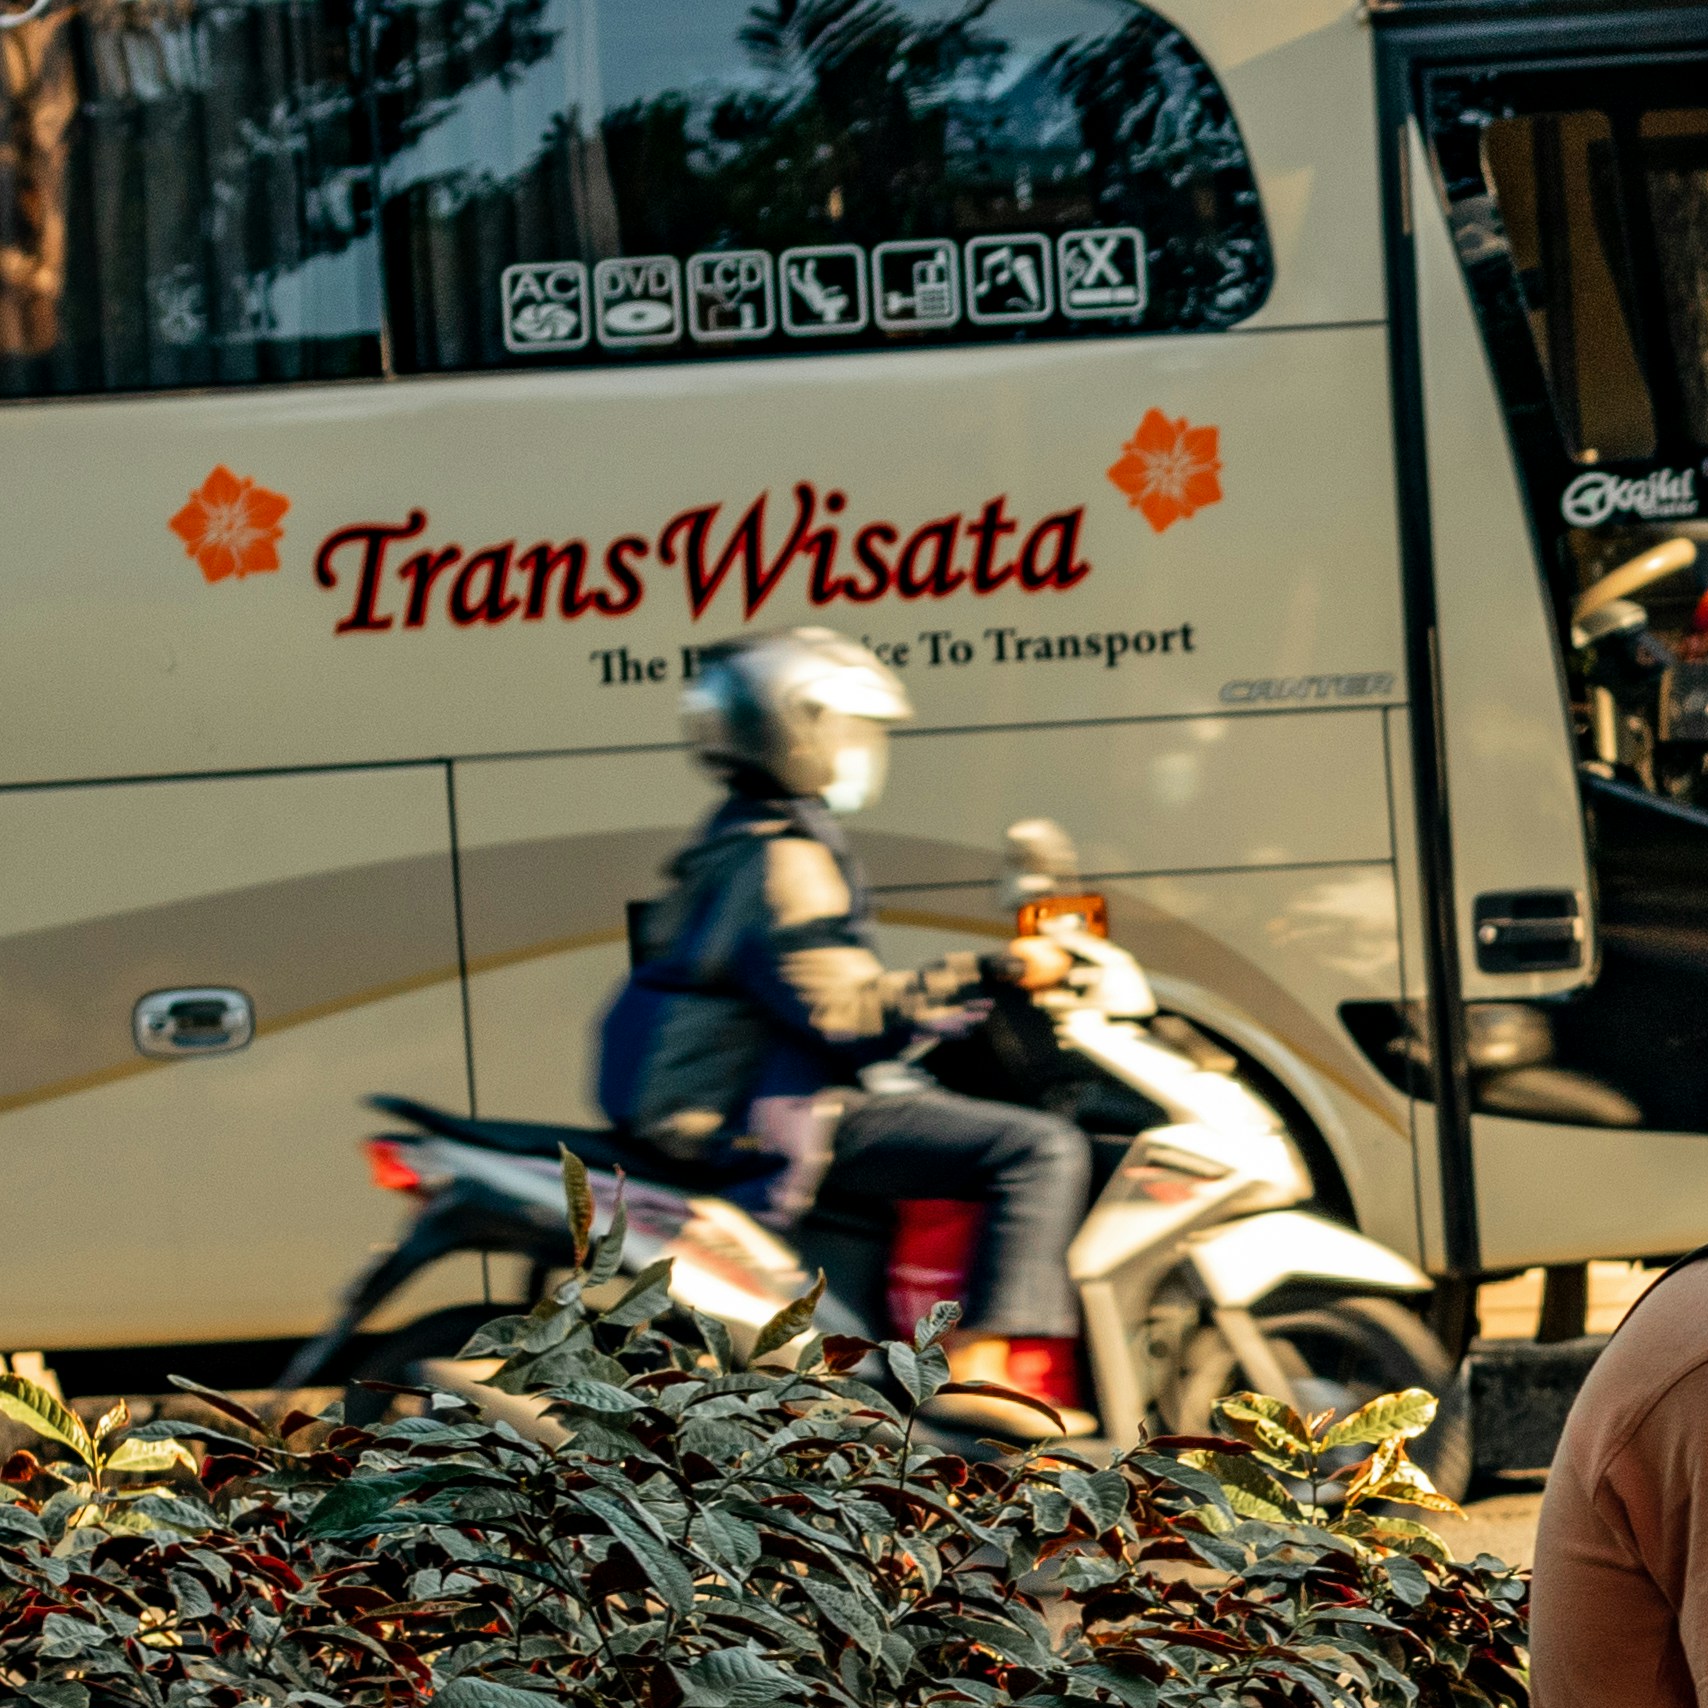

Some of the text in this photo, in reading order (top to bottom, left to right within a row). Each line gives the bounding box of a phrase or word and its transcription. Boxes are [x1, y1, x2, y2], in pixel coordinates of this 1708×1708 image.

[511, 258, 764, 302] AC DVD LCD
[590, 645, 668, 685] The
[919, 629, 975, 668] To
[983, 621, 1197, 669] Transport
